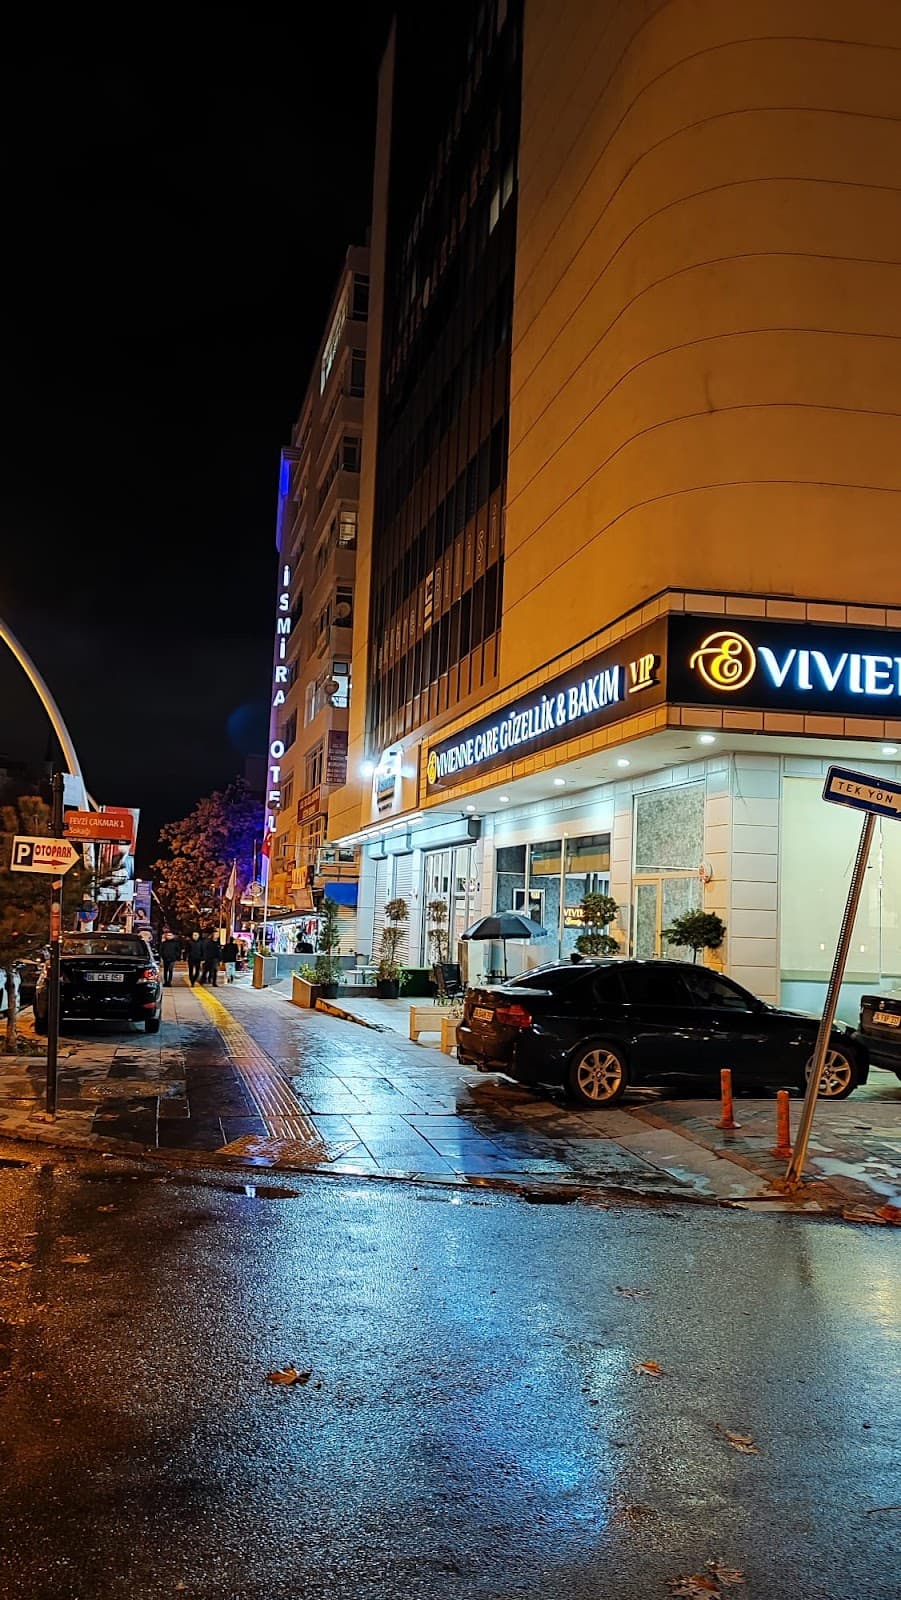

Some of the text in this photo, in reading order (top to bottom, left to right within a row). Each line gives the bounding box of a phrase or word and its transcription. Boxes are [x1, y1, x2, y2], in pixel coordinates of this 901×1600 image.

[629, 653, 654, 684] VIP
[436, 665, 620, 777] VIVIENNE CARE GÜZELLİK & BAKIM
[268, 741, 284, 832] OTEL
[837, 781, 893, 803] TEK YÖN
[16, 843, 72, 864] P OTOPARK
